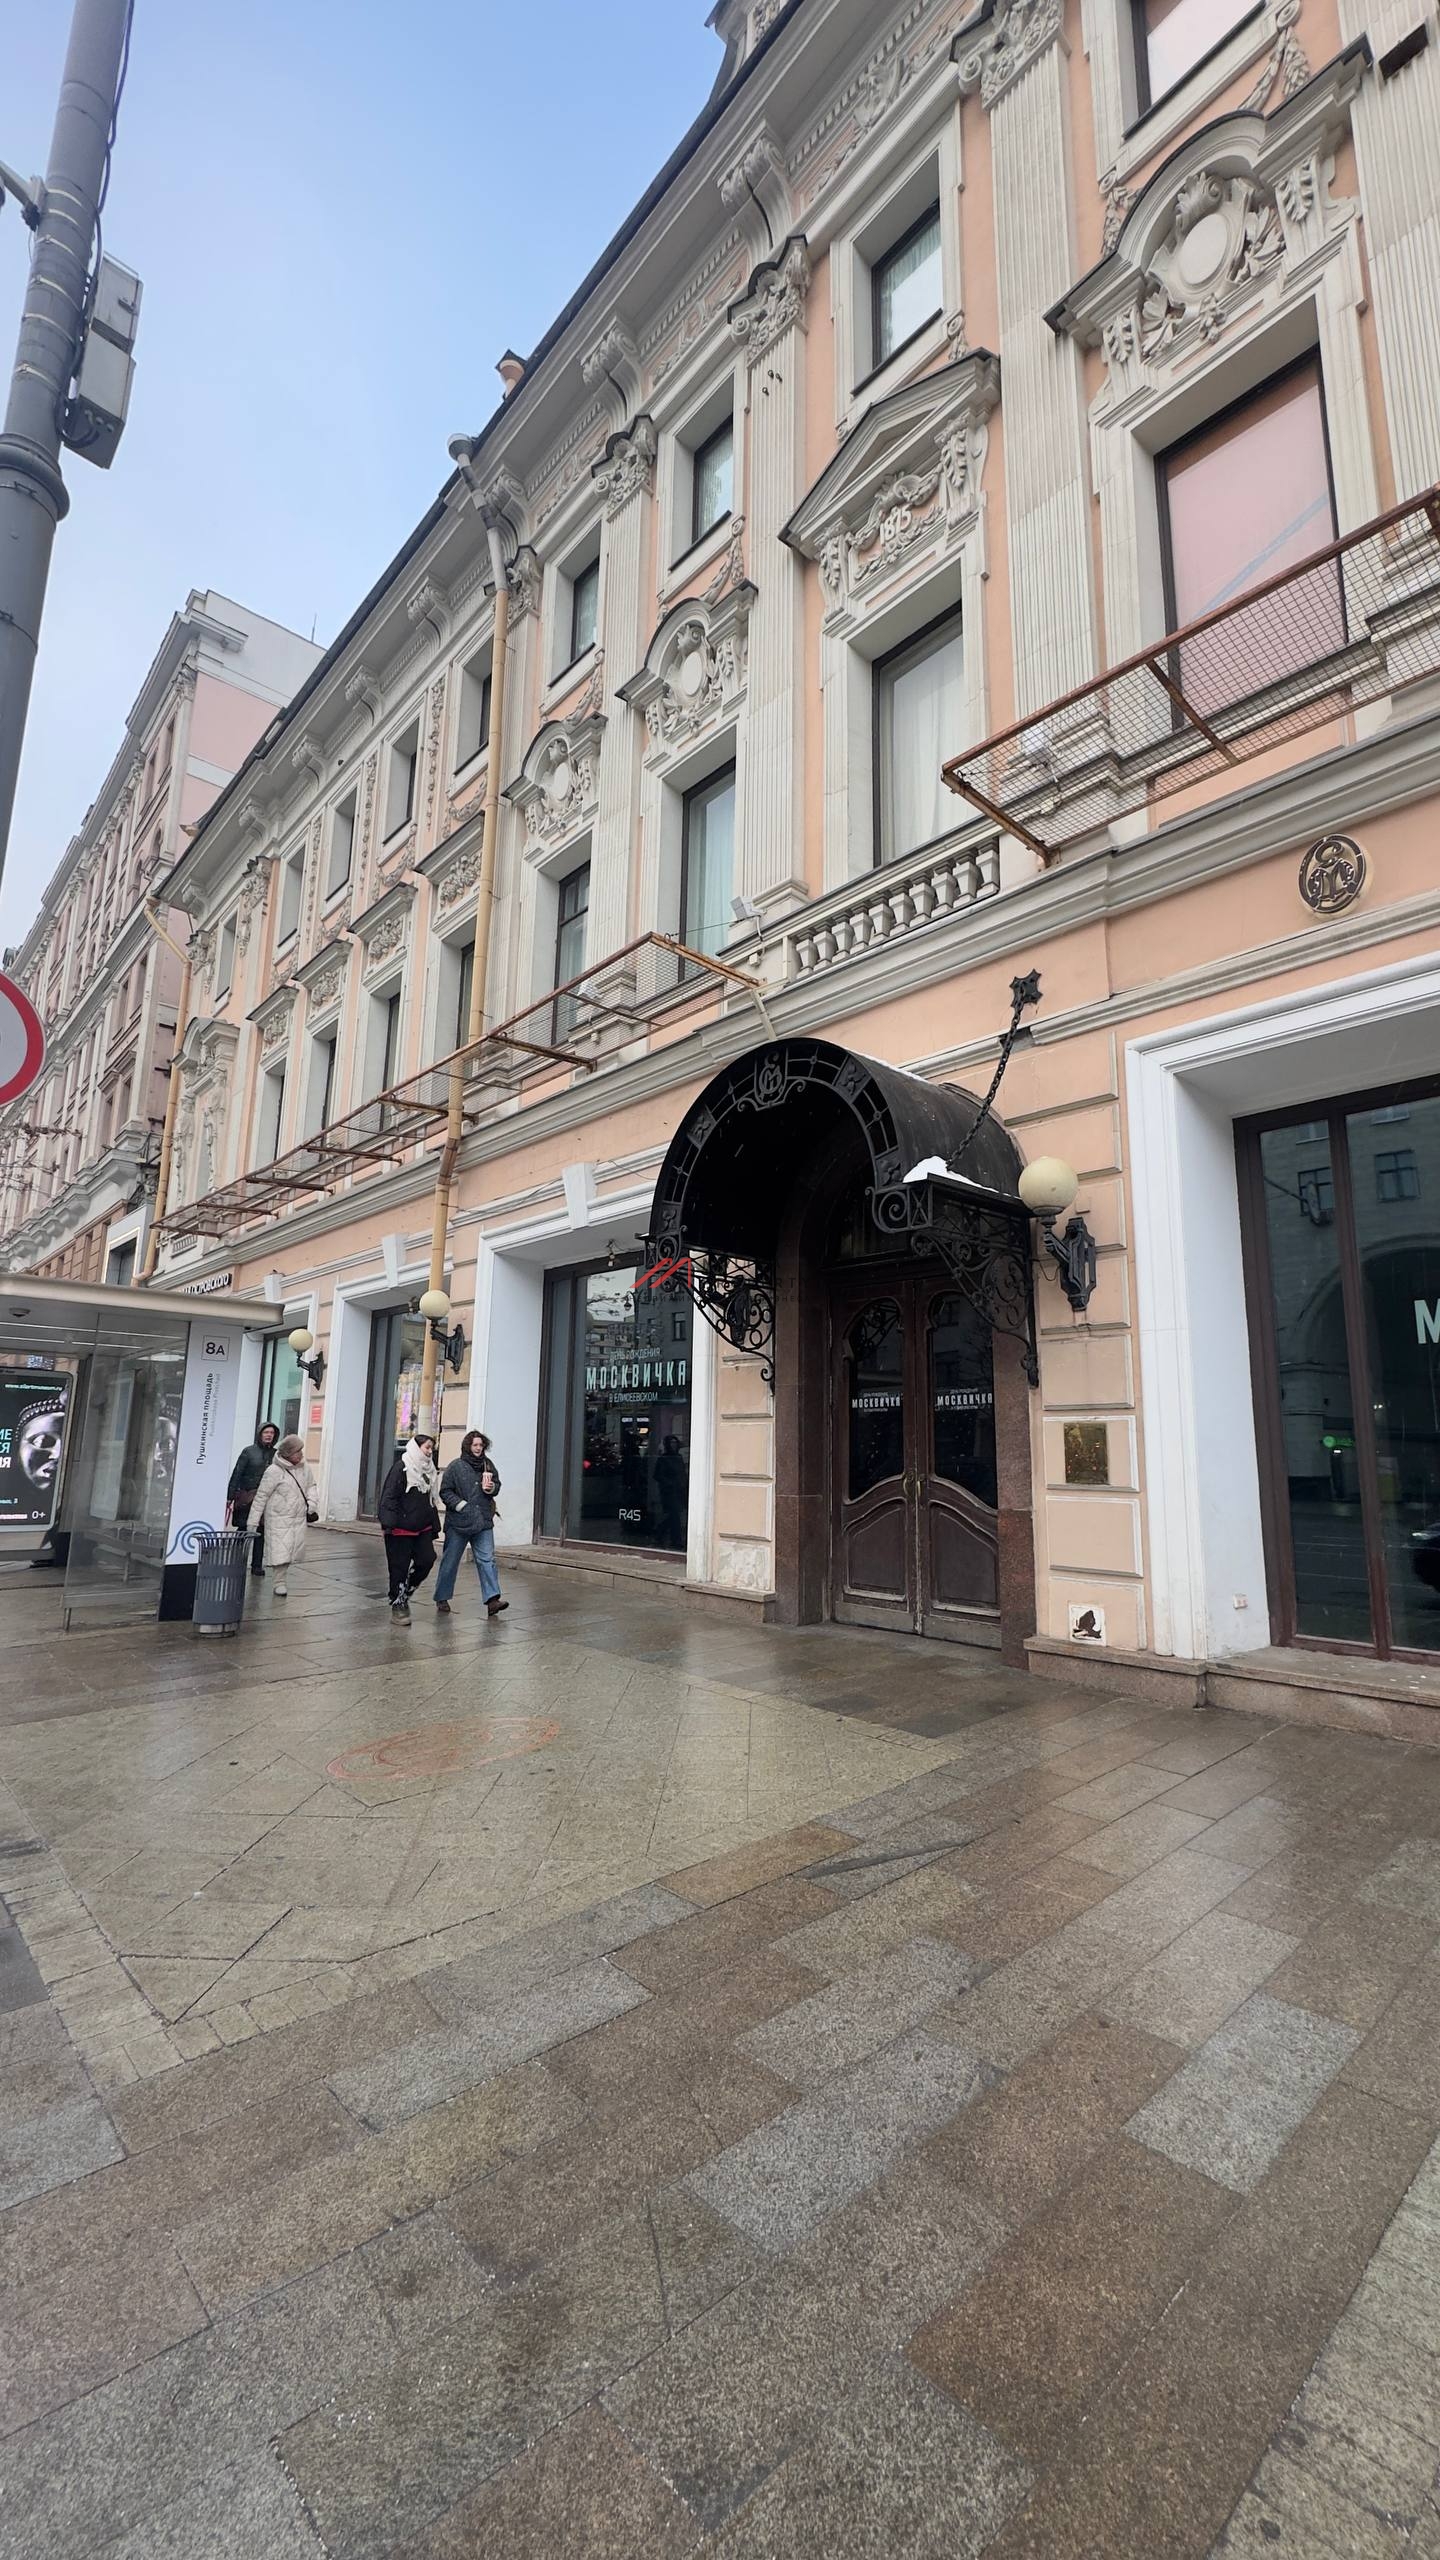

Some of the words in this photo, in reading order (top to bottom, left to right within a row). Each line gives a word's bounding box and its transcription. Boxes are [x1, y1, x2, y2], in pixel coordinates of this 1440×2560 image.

[586, 1360, 687, 1391] МОСКВИЧКА
[614, 1390, 659, 1402] ЕЛИСЕЕВСКОМ
[852, 1397, 901, 1408] МОСКВИЧКА
[937, 1392, 993, 1406] МОСКВИЧКА
[196, 1412, 208, 1465] Пушкинская
[204, 1372, 213, 1411] площадь
[31, 1510, 46, 1520] 0+
[619, 1508, 641, 1522] R4S
